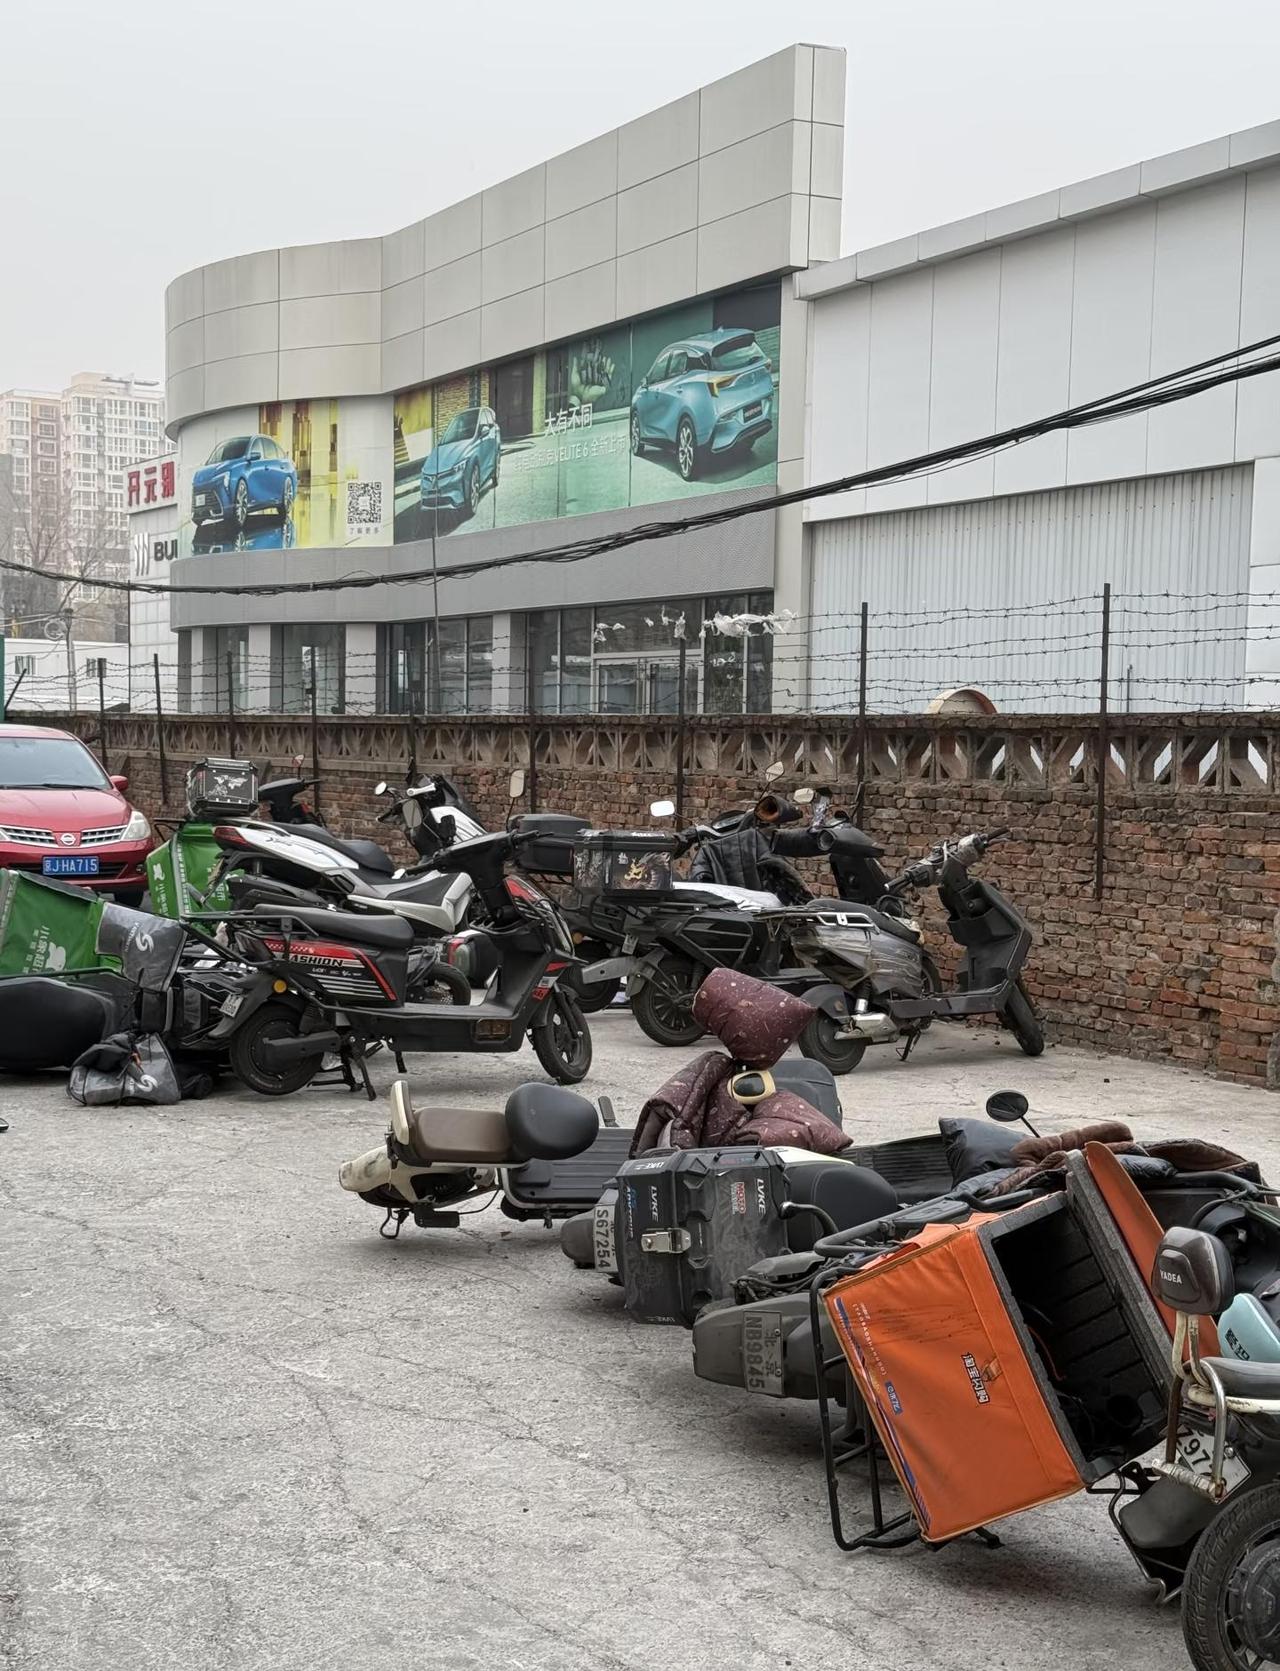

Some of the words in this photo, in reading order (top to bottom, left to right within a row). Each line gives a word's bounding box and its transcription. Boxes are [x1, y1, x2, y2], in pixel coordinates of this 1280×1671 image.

[544, 402, 593, 438] 大有不同
[289, 954, 344, 968] ASHION
[649, 1185, 659, 1223] LVKE
[756, 1178, 767, 1216] LVKE
[595, 1209, 610, 1269] S67254
[1159, 1269, 1183, 1285] YADEA
[746, 1316, 766, 1389] NB9845
[962, 1353, 989, 1403] 淘宝闪购
